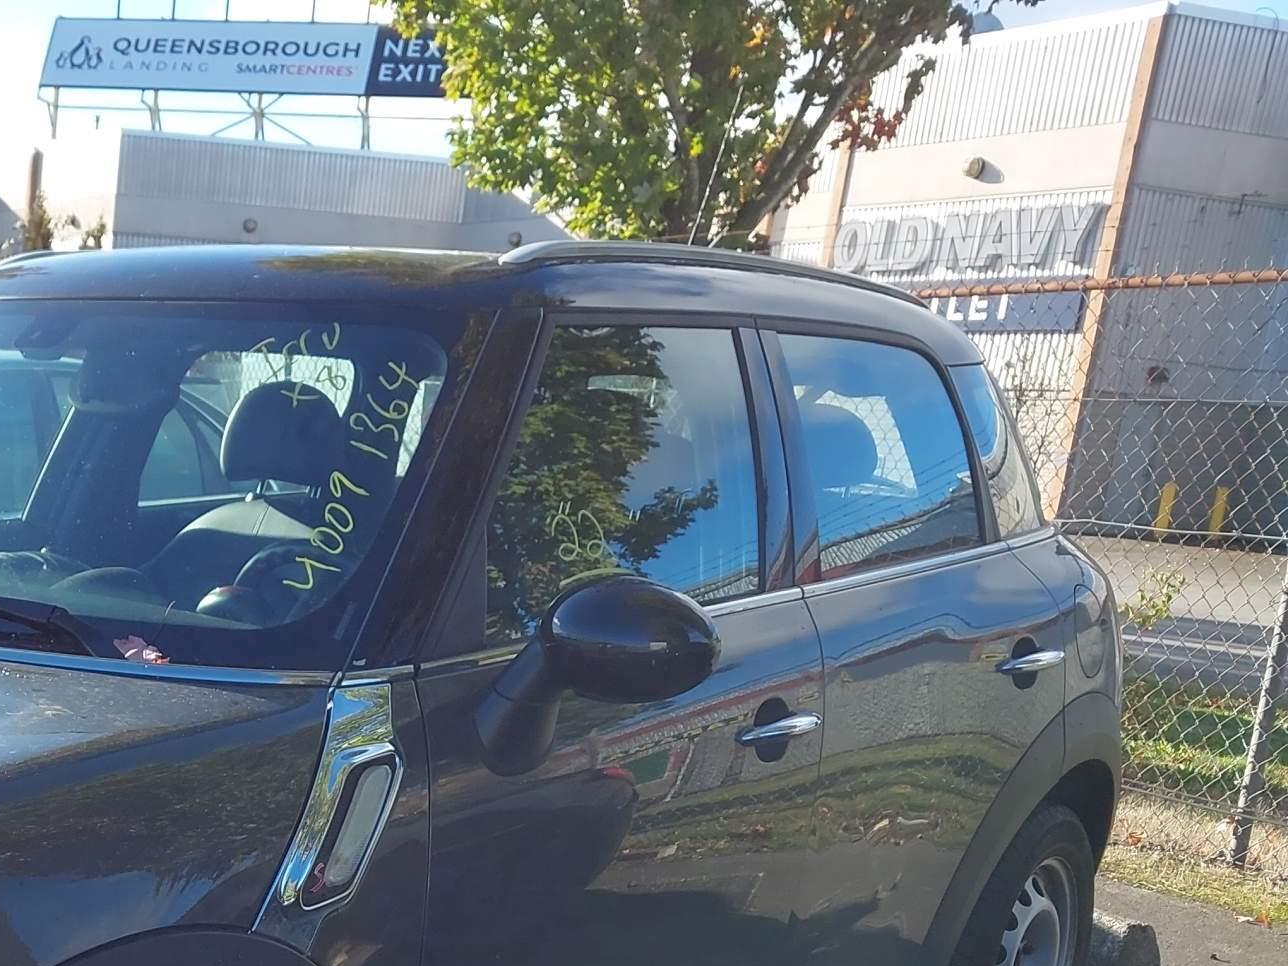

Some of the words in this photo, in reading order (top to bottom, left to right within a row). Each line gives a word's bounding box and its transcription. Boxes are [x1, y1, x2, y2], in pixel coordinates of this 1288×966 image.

[113, 37, 360, 59] QUEENSBOROUGH
[383, 38, 442, 58] NEX
[108, 60, 209, 73] LANDING
[236, 62, 353, 77] SMARTCENTRES
[378, 62, 443, 82] EXIT
[832, 216, 933, 272] OLD
[941, 204, 1100, 268] NAVY
[282, 471, 370, 589] 4009
[349, 361, 420, 460] 1364
